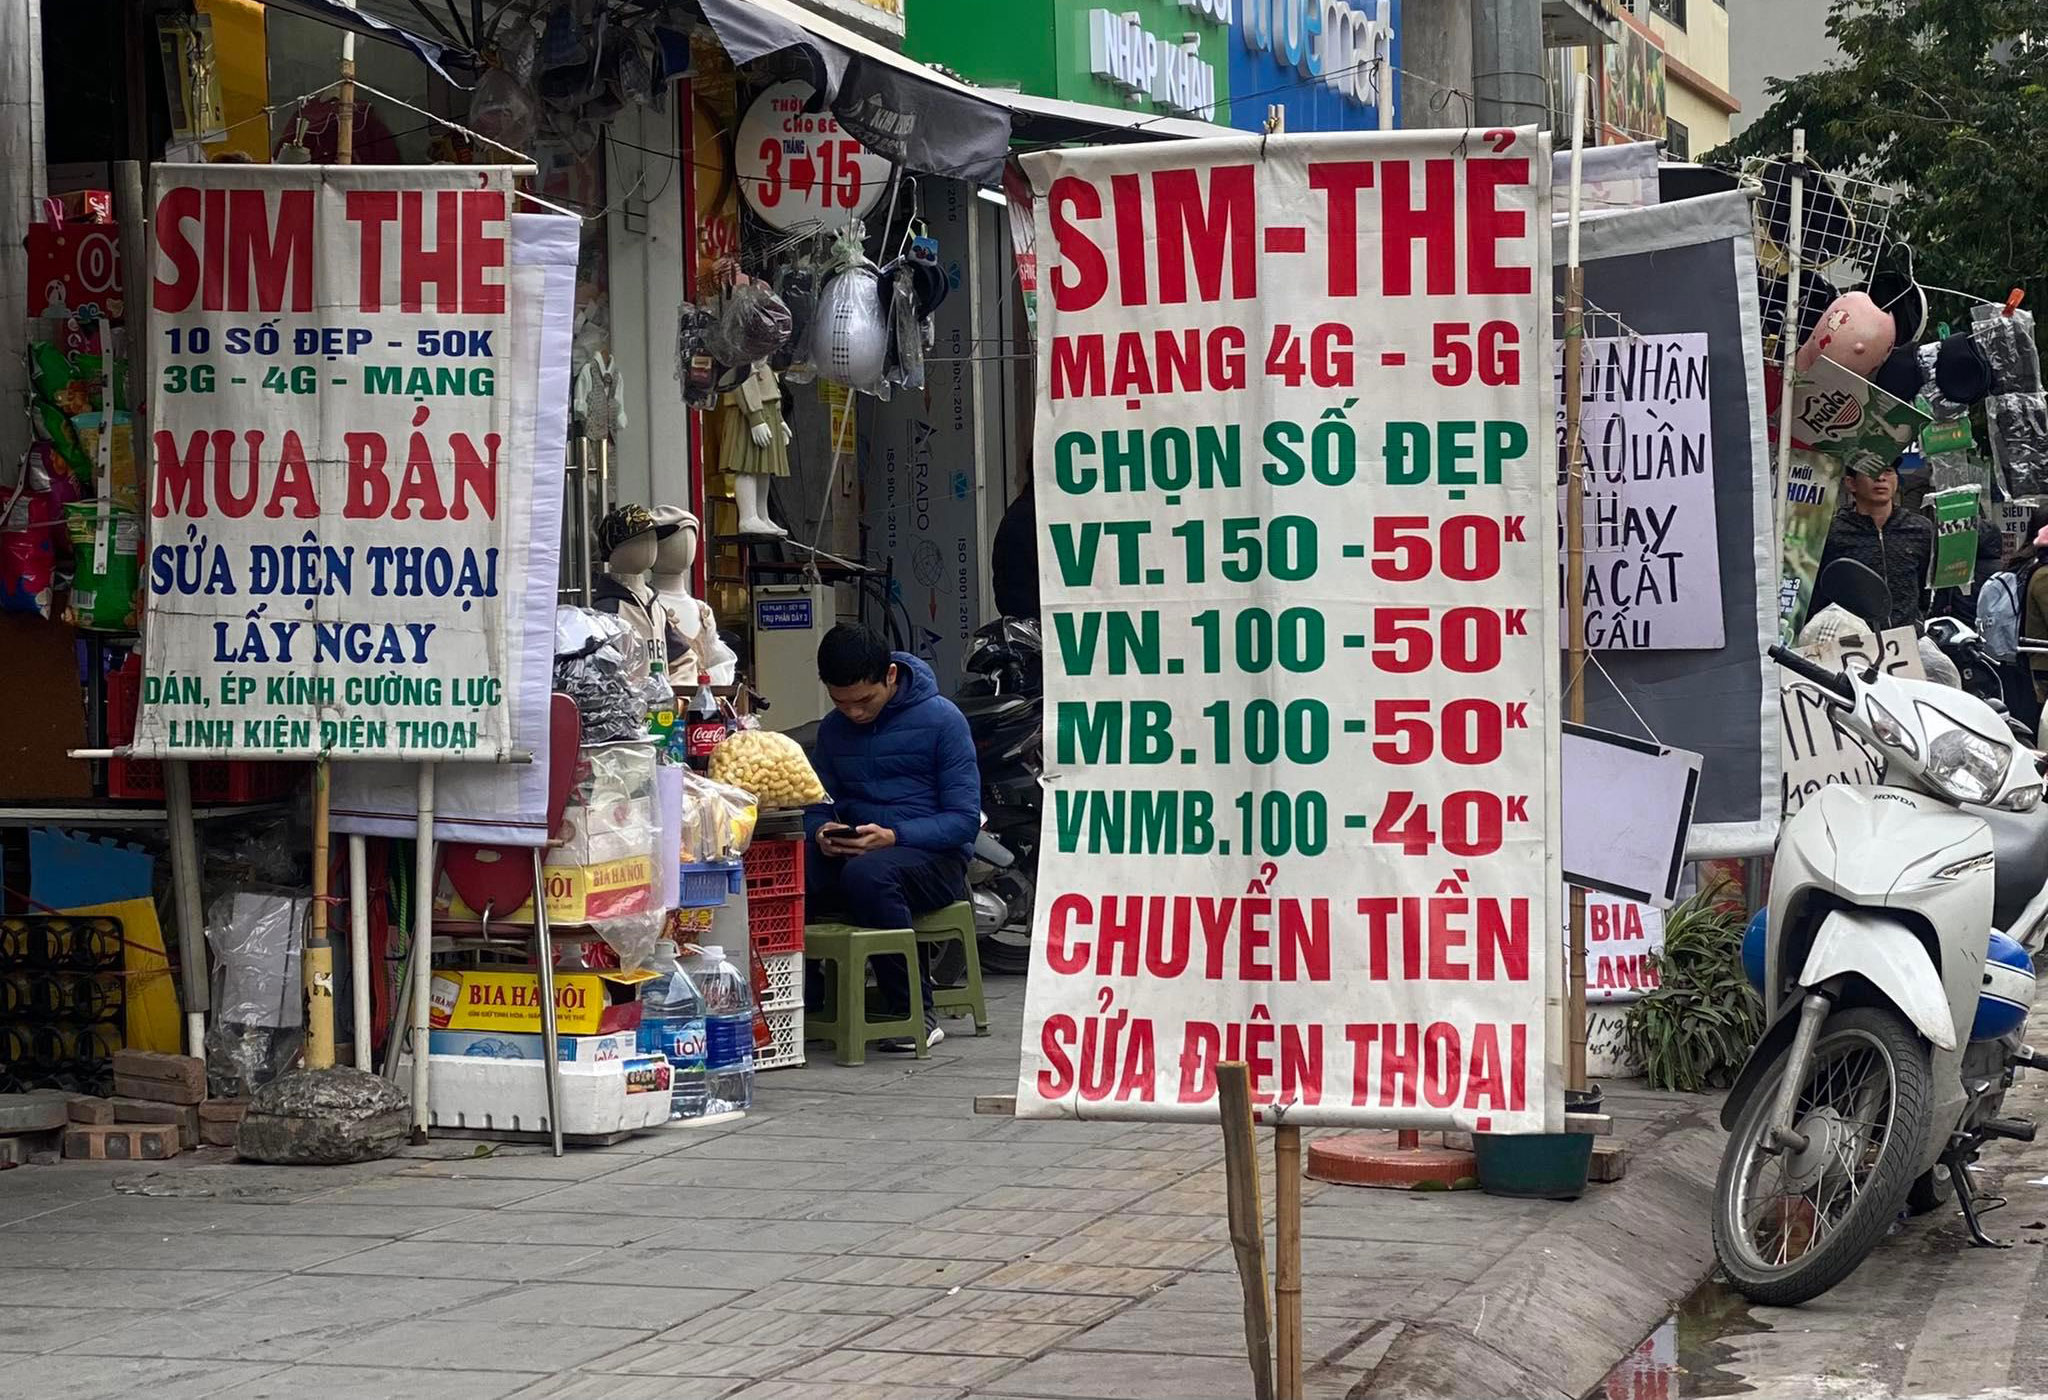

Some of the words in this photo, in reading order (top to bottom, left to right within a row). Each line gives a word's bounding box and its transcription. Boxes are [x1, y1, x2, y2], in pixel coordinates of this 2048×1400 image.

[1090, 9, 1158, 103] NHẬP
[1152, 32, 1215, 122] KHẨU
[783, 118, 814, 133] CHO
[758, 137, 782, 208] 3
[782, 138, 805, 154] THÁNG
[816, 139, 862, 209] 15
[153, 186, 316, 314] SIM
[345, 171, 506, 314] THẺ
[1049, 129, 1532, 312] SIM-THẺ
[165, 328, 209, 355] 10
[225, 318, 280, 356] SỐ
[293, 328, 372, 361] ĐẸP
[417, 330, 494, 358] 50K
[1050, 322, 1247, 411] MẠNG
[1265, 320, 1355, 388] 4G
[1431, 319, 1521, 387] 5G
[164, 364, 216, 394] 3G
[262, 366, 317, 394] 4G
[364, 366, 495, 402] MẠNG
[1605, 342, 1708, 406] NHẬN
[151, 429, 320, 518] MUA
[342, 405, 502, 521] BÁN
[1054, 422, 1242, 505] CHỌN
[1262, 397, 1359, 487] SỐ
[1382, 420, 1529, 500] ĐẸP
[1602, 407, 1706, 486] QUẦN
[1596, 491, 1678, 555] HAY
[151, 524, 236, 595] SỬA
[249, 530, 354, 612] ĐIỆN
[367, 547, 499, 612] THOẠI
[213, 602, 300, 663] LẤY
[312, 622, 436, 664] NGAY
[1584, 606, 1650, 649] GẤU
[144, 672, 210, 709] DÁN,
[220, 671, 256, 704] ÉP
[267, 671, 335, 705] KÍNH
[345, 671, 441, 706] CƯỜNG
[451, 675, 502, 712] LỰC
[169, 720, 233, 748] LINH
[244, 715, 311, 753] KIỆN
[319, 715, 386, 753] ĐIỆN
[395, 722, 477, 754] THOẠI
[1873, 793, 1917, 810] HONDA
[1046, 862, 1331, 982] CHUYỂN
[1357, 868, 1530, 982] TIỀN
[1590, 903, 1645, 942] BIA
[469, 984, 508, 1006] BIA
[1037, 986, 1155, 1102] SỬA
[1178, 1003, 1322, 1122] ĐIỆN
[1344, 1021, 1527, 1132] THOẠI
